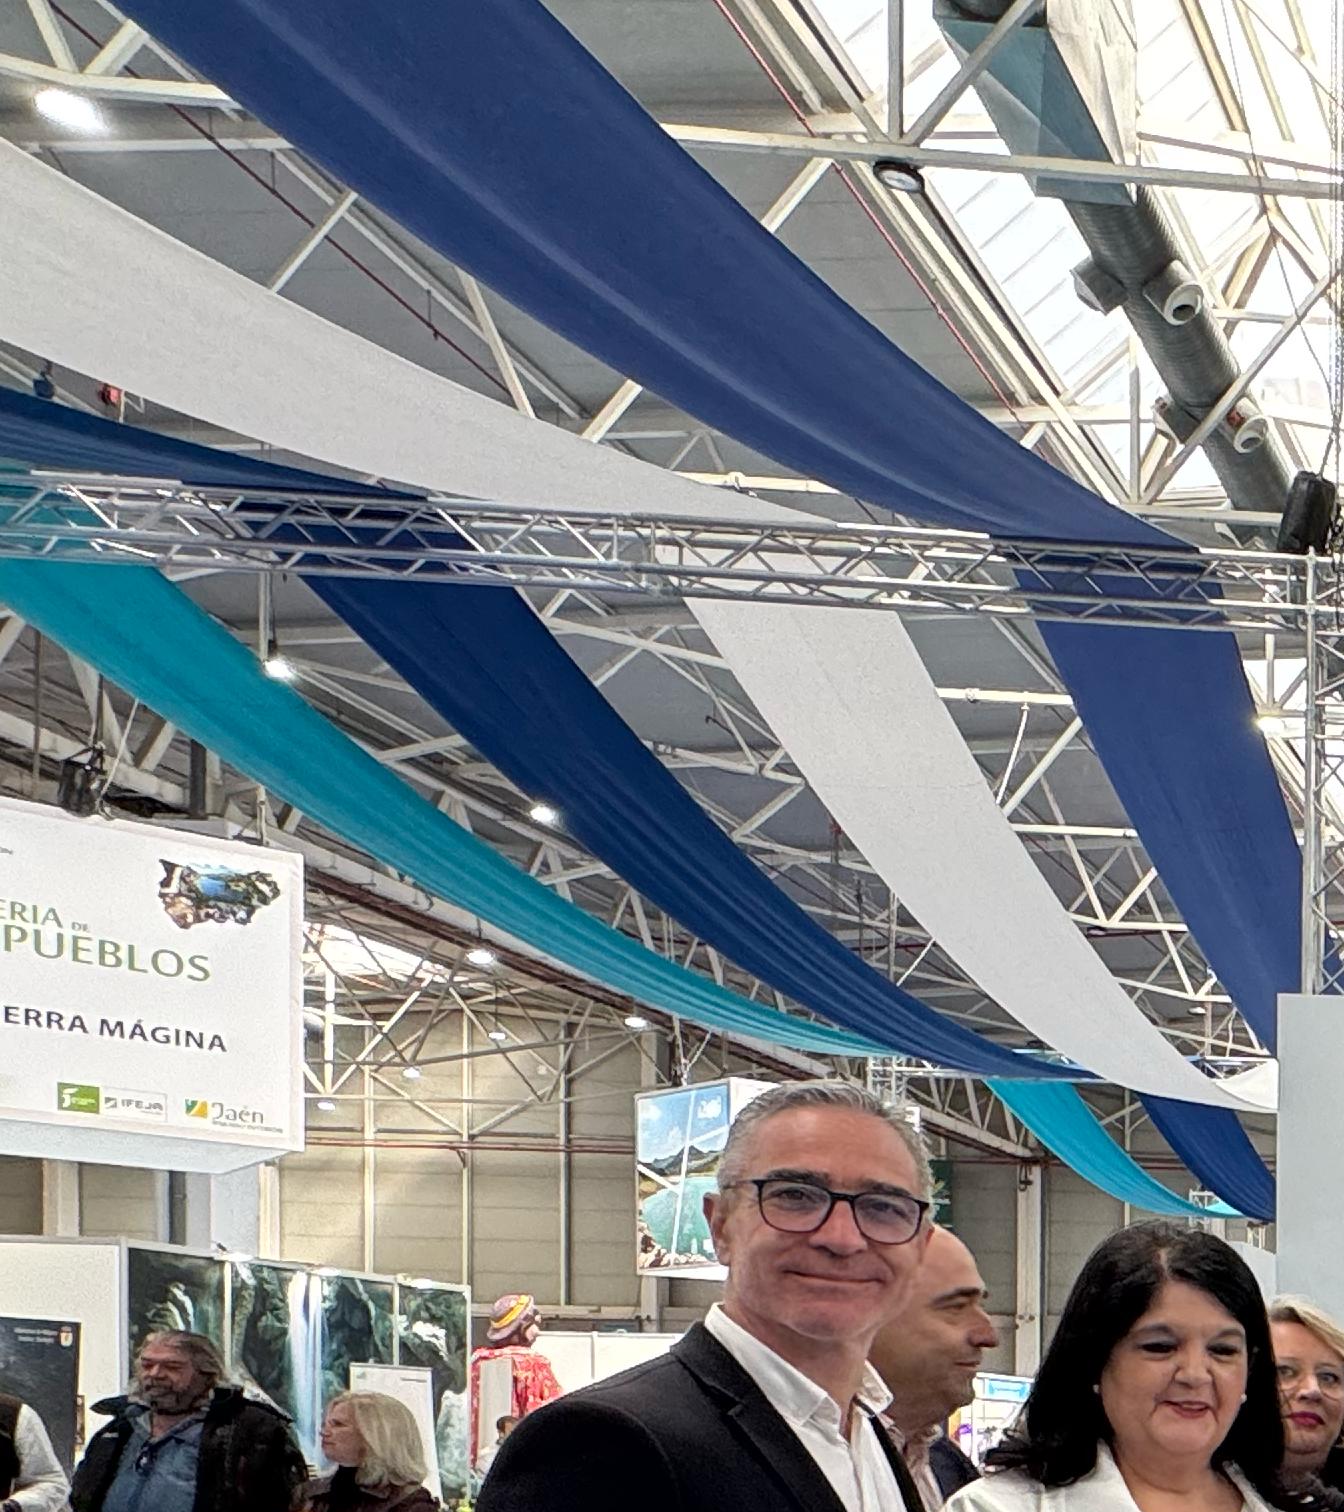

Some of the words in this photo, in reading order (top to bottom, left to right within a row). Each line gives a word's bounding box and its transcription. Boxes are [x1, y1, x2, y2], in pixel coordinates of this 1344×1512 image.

[71, 921, 89, 932] DE
[3, 924, 210, 982] PUEBLOS
[98, 1018, 228, 1053] MÁGINA
[211, 1102, 264, 1125] Jaén
